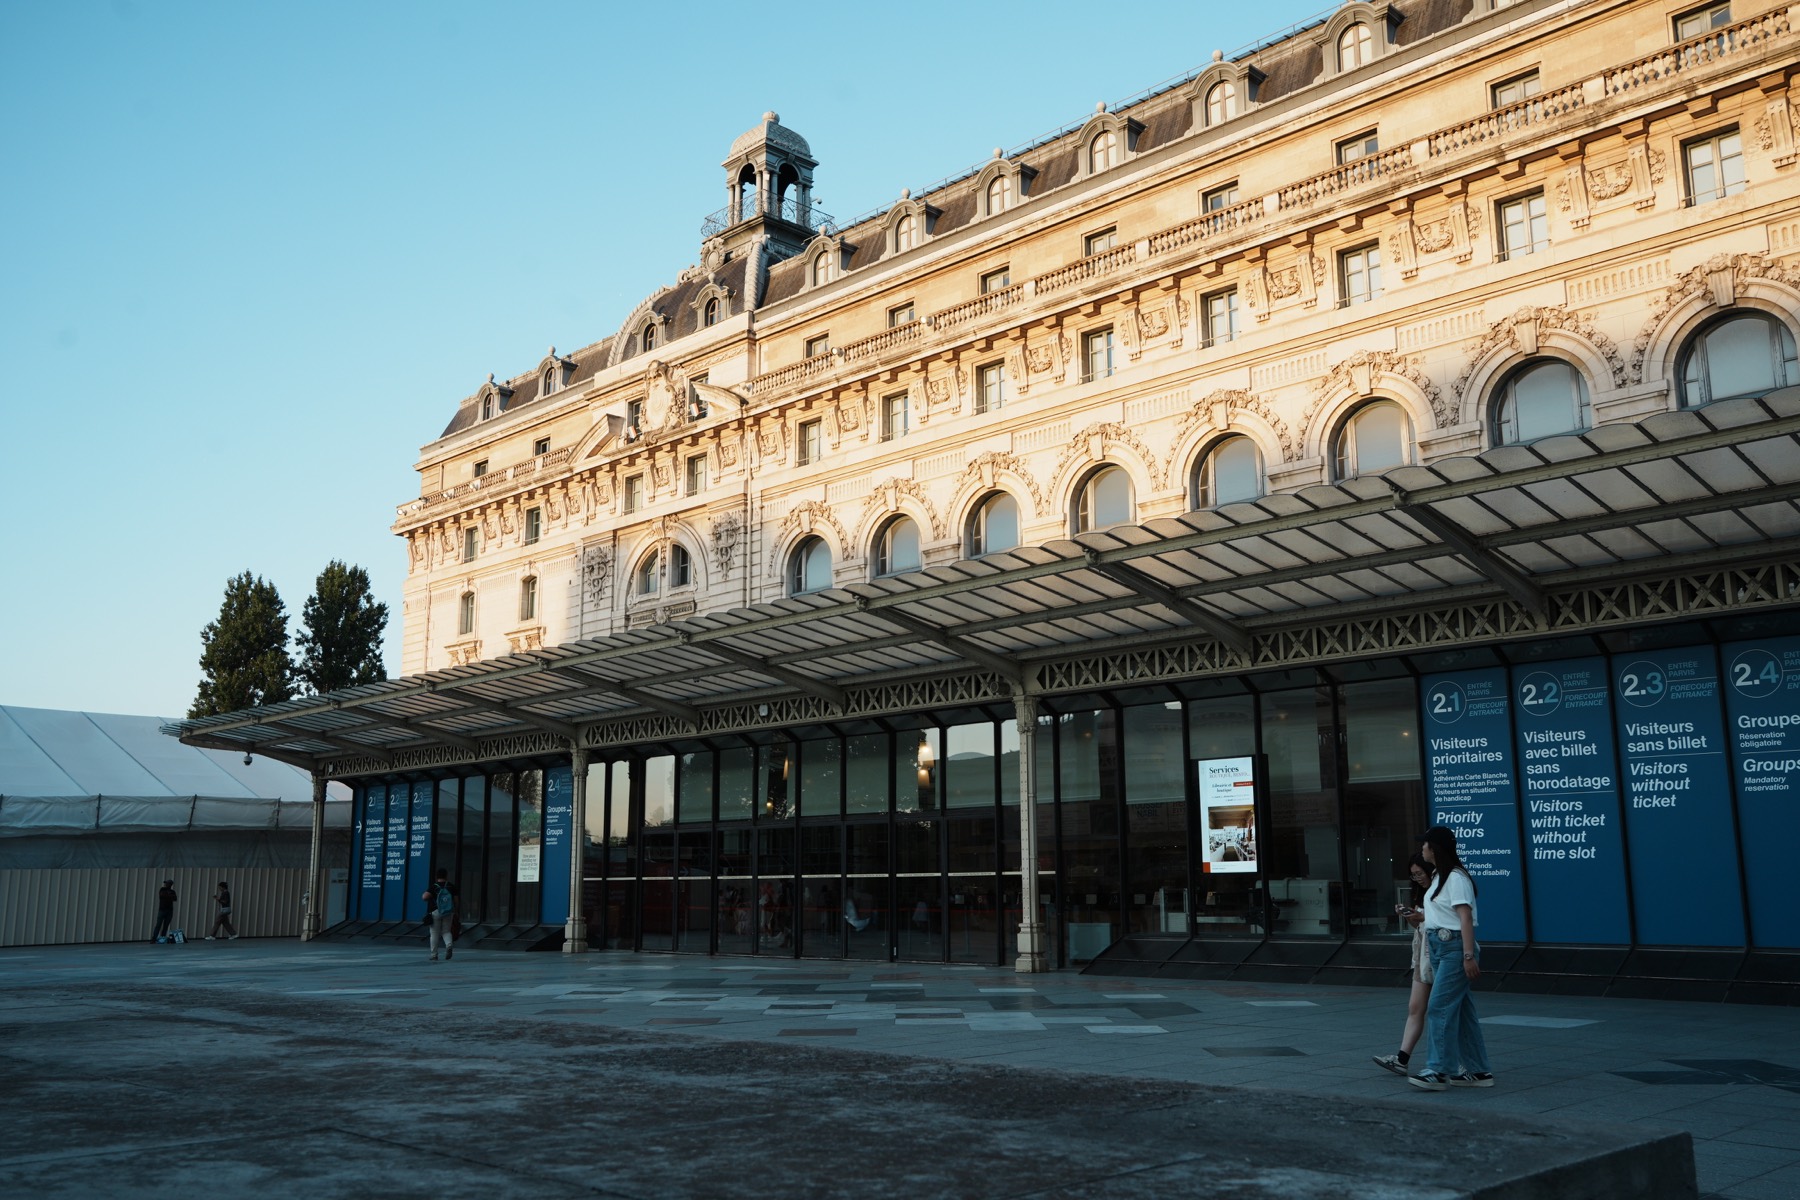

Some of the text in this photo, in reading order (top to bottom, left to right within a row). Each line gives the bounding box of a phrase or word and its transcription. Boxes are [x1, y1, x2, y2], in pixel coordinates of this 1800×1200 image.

[1784, 651, 1800, 659] ENT
[1668, 660, 1699, 670] ENTRÉE
[1785, 659, 1800, 667] PAR
[1563, 672, 1590, 680] ENTRÉE
[1668, 669, 1695, 677] PARVIS
[1734, 660, 1778, 686] 2.4
[1467, 681, 1492, 690] ENTRÉE
[1622, 672, 1663, 696] 2.3
[1670, 682, 1717, 692] FORECOURT
[1522, 682, 1558, 705] 2.2
[1565, 692, 1607, 701] FORECOURT
[1671, 690, 1713, 700] ENTRANCE
[1433, 692, 1460, 713] 2.1
[1469, 701, 1507, 709] FORECOURT
[1565, 699, 1603, 708] ENTRANCE
[1469, 708, 1504, 716] ENTRANCE
[1738, 715, 1800, 728] Groupe
[1625, 722, 1694, 736] Visiteurs
[1524, 730, 1586, 744] Visiteurs
[1739, 732, 1786, 740] Réservation
[1431, 737, 1487, 750] Visiteurs
[1627, 736, 1707, 753] sans billet
[1740, 740, 1782, 748] obligatoire
[1526, 743, 1597, 759] avec billet
[1433, 751, 1503, 767] prioritaires
[1209, 766, 1239, 774] Services
[1527, 763, 1560, 774] sans
[1630, 762, 1688, 776] Visitors
[548, 779, 560, 791] 2.4
[1528, 776, 1610, 790] horodatage
[1631, 777, 1691, 792] without
[1744, 776, 1786, 784] Mandatory
[1745, 784, 1789, 792] reservation
[1530, 800, 1583, 812] Visitors
[1633, 794, 1677, 809] ticket
[1436, 811, 1483, 825] Priority
[1531, 814, 1605, 828] with ticket
[547, 828, 563, 836] Groups
[1451, 826, 1484, 838] itors
[1532, 831, 1586, 844] without
[1533, 846, 1596, 859] time slot
[1482, 869, 1510, 877] disability
